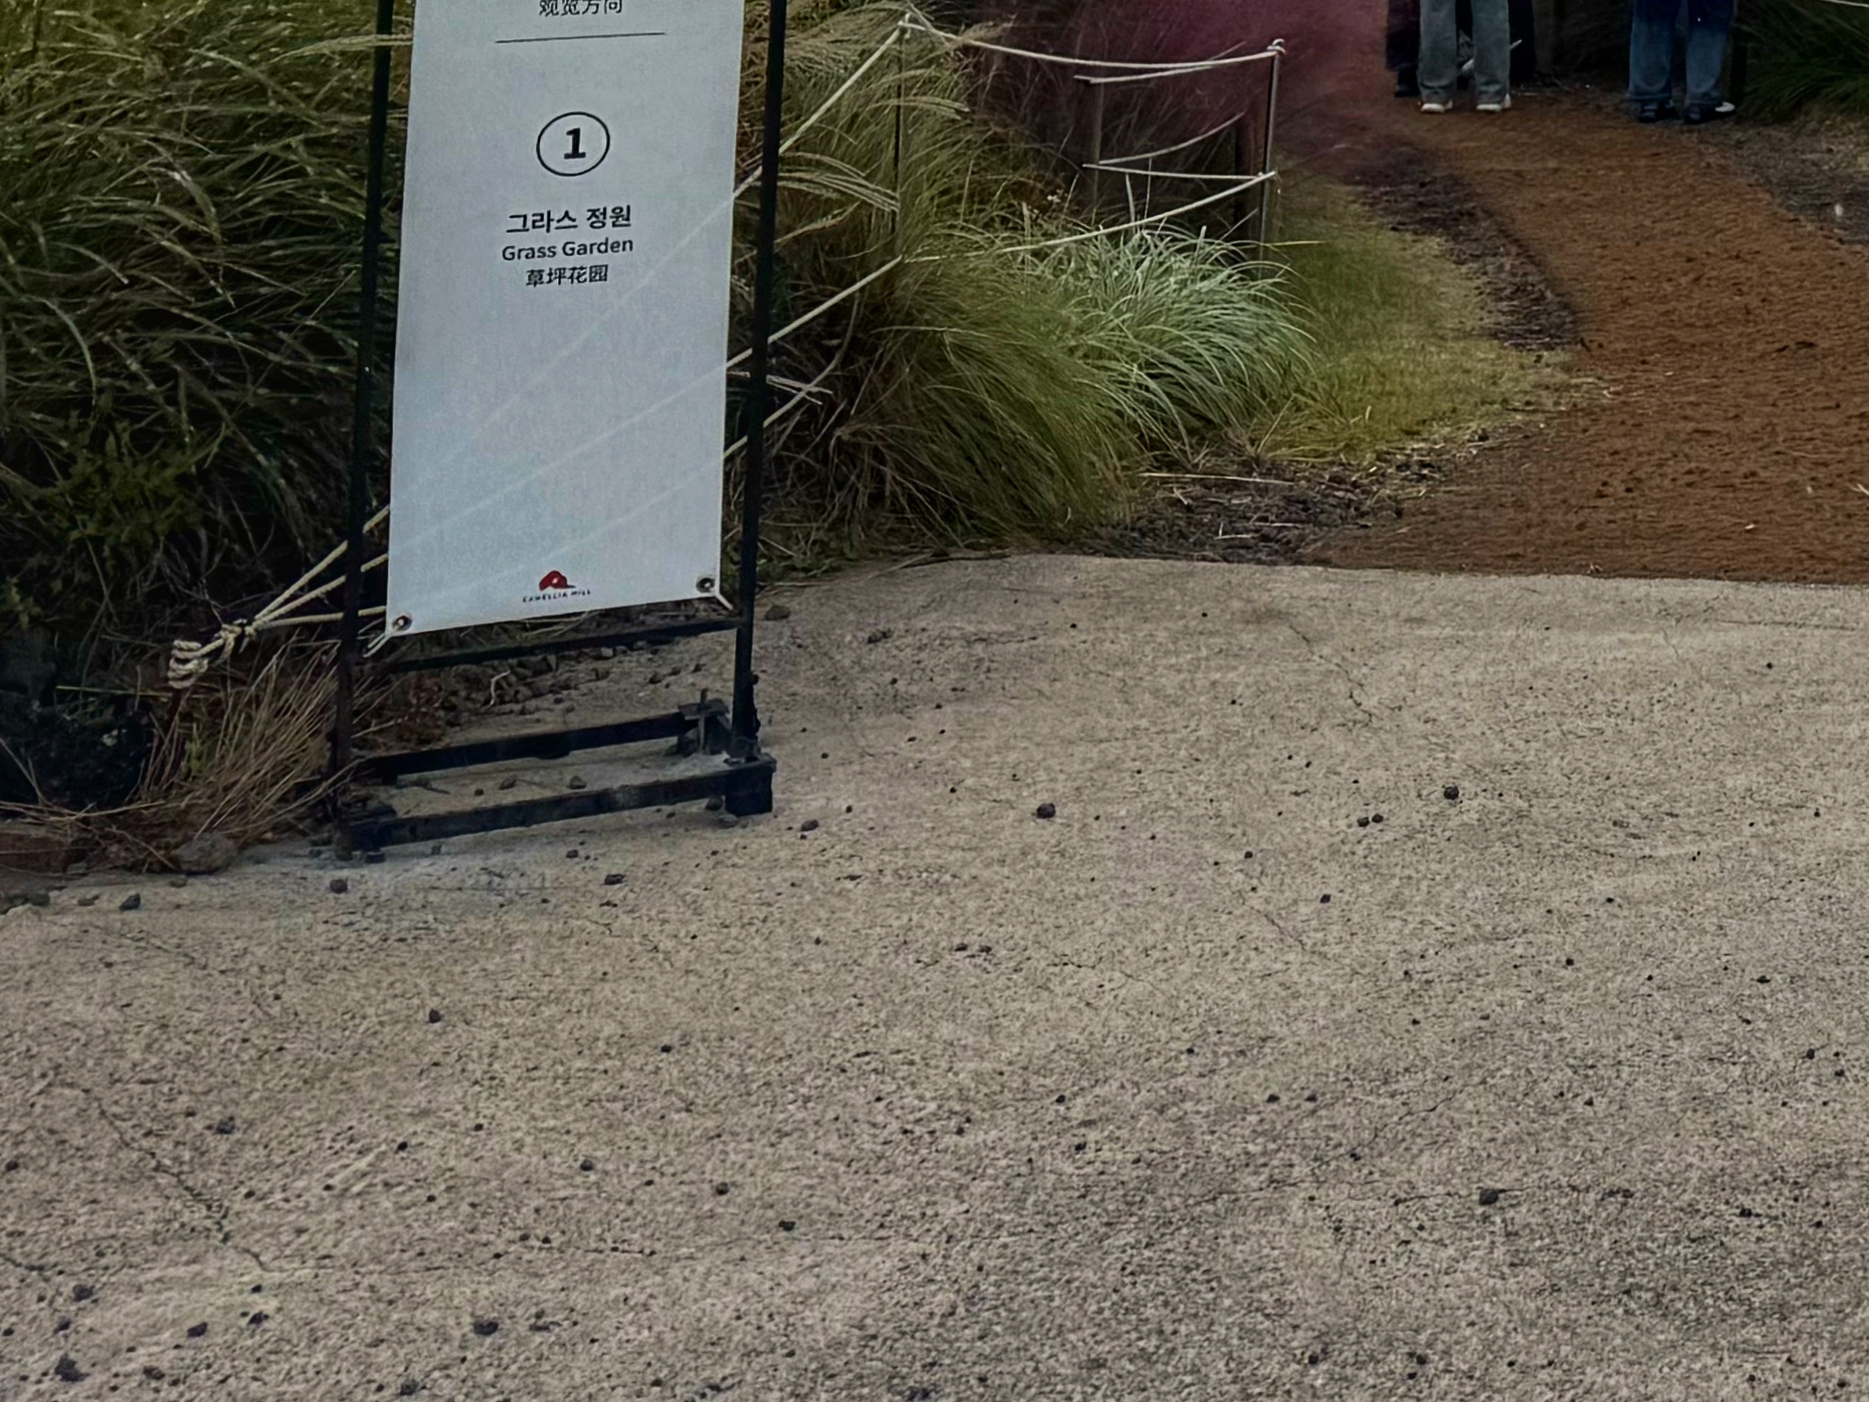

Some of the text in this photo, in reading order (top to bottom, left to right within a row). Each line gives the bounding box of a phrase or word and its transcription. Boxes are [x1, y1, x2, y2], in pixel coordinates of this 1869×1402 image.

[564, 127, 587, 160] 1
[506, 204, 631, 234] 그라스 정원
[502, 237, 634, 261] Grass Garden
[526, 264, 609, 288] 草坪花园
